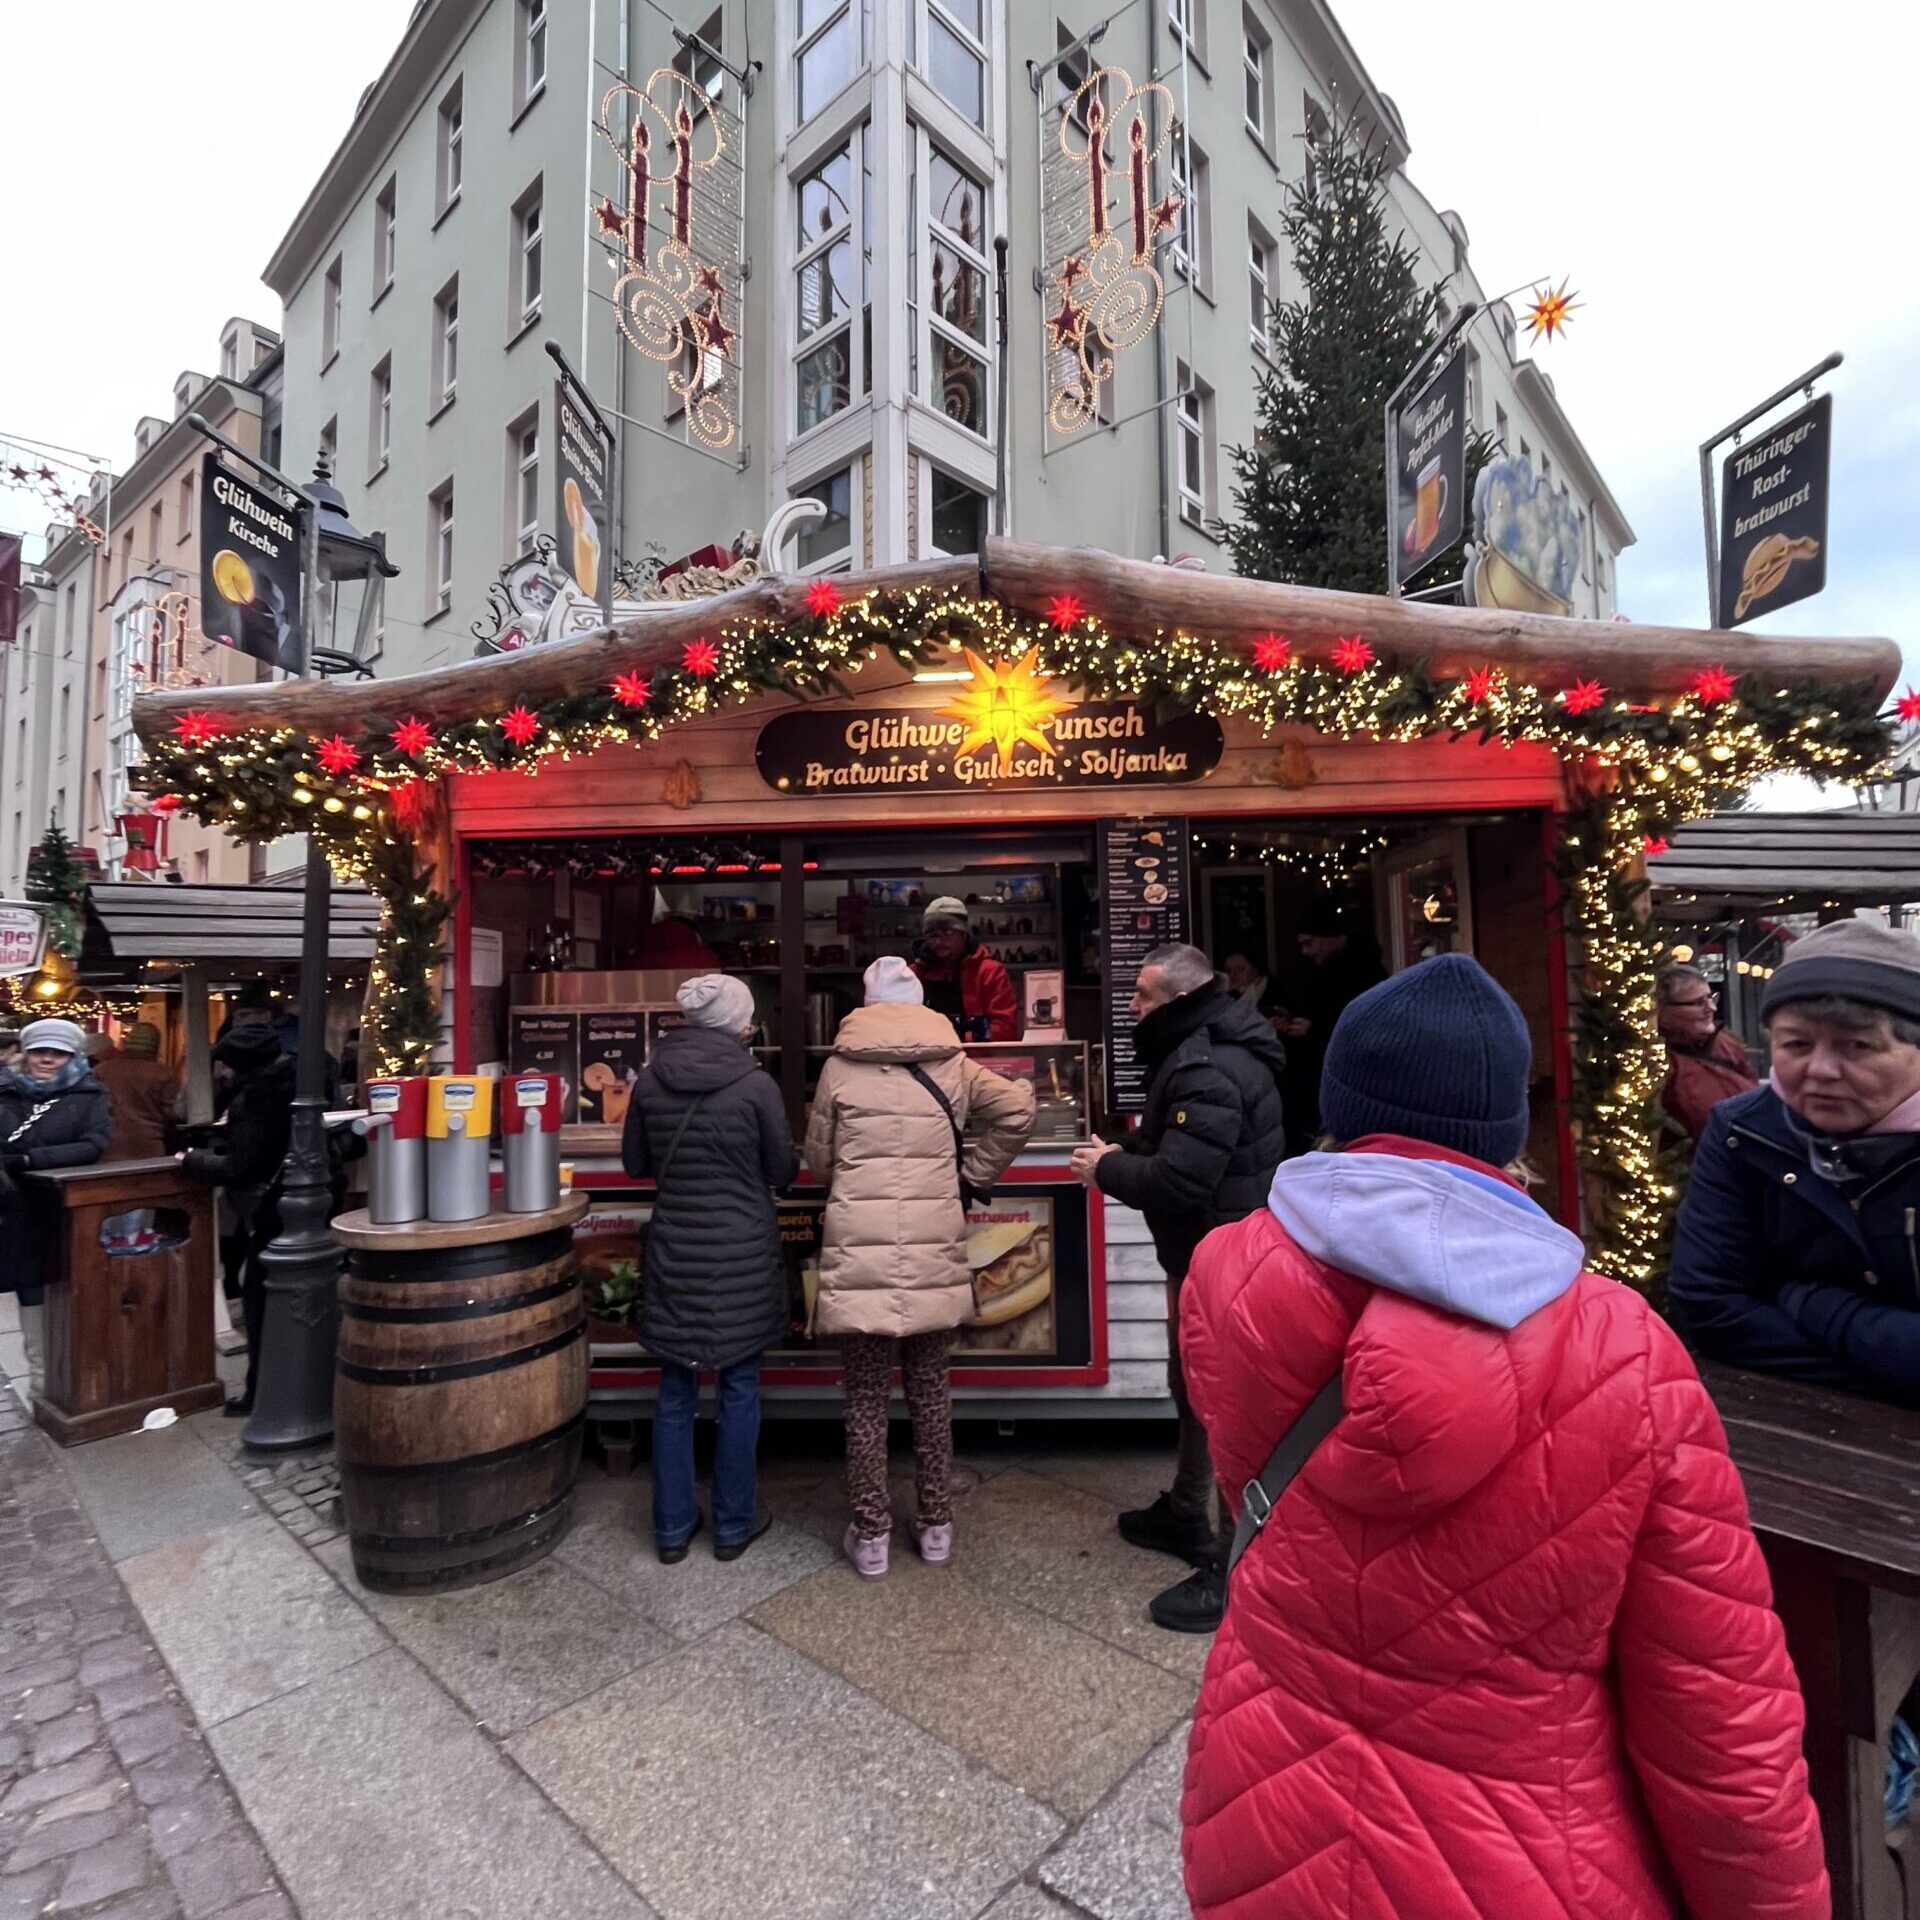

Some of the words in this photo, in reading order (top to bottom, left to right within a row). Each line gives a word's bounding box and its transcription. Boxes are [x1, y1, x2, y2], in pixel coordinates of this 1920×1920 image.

[561, 404, 603, 476] Glühwein
[1751, 464, 1792, 500] Rost-
[212, 476, 294, 541] Glühwein
[1734, 482, 1811, 539] bratwurst
[228, 515, 279, 558] Kirsche
[805, 760, 930, 787] Bratwurst
[1079, 746, 1188, 780] Soljanka
